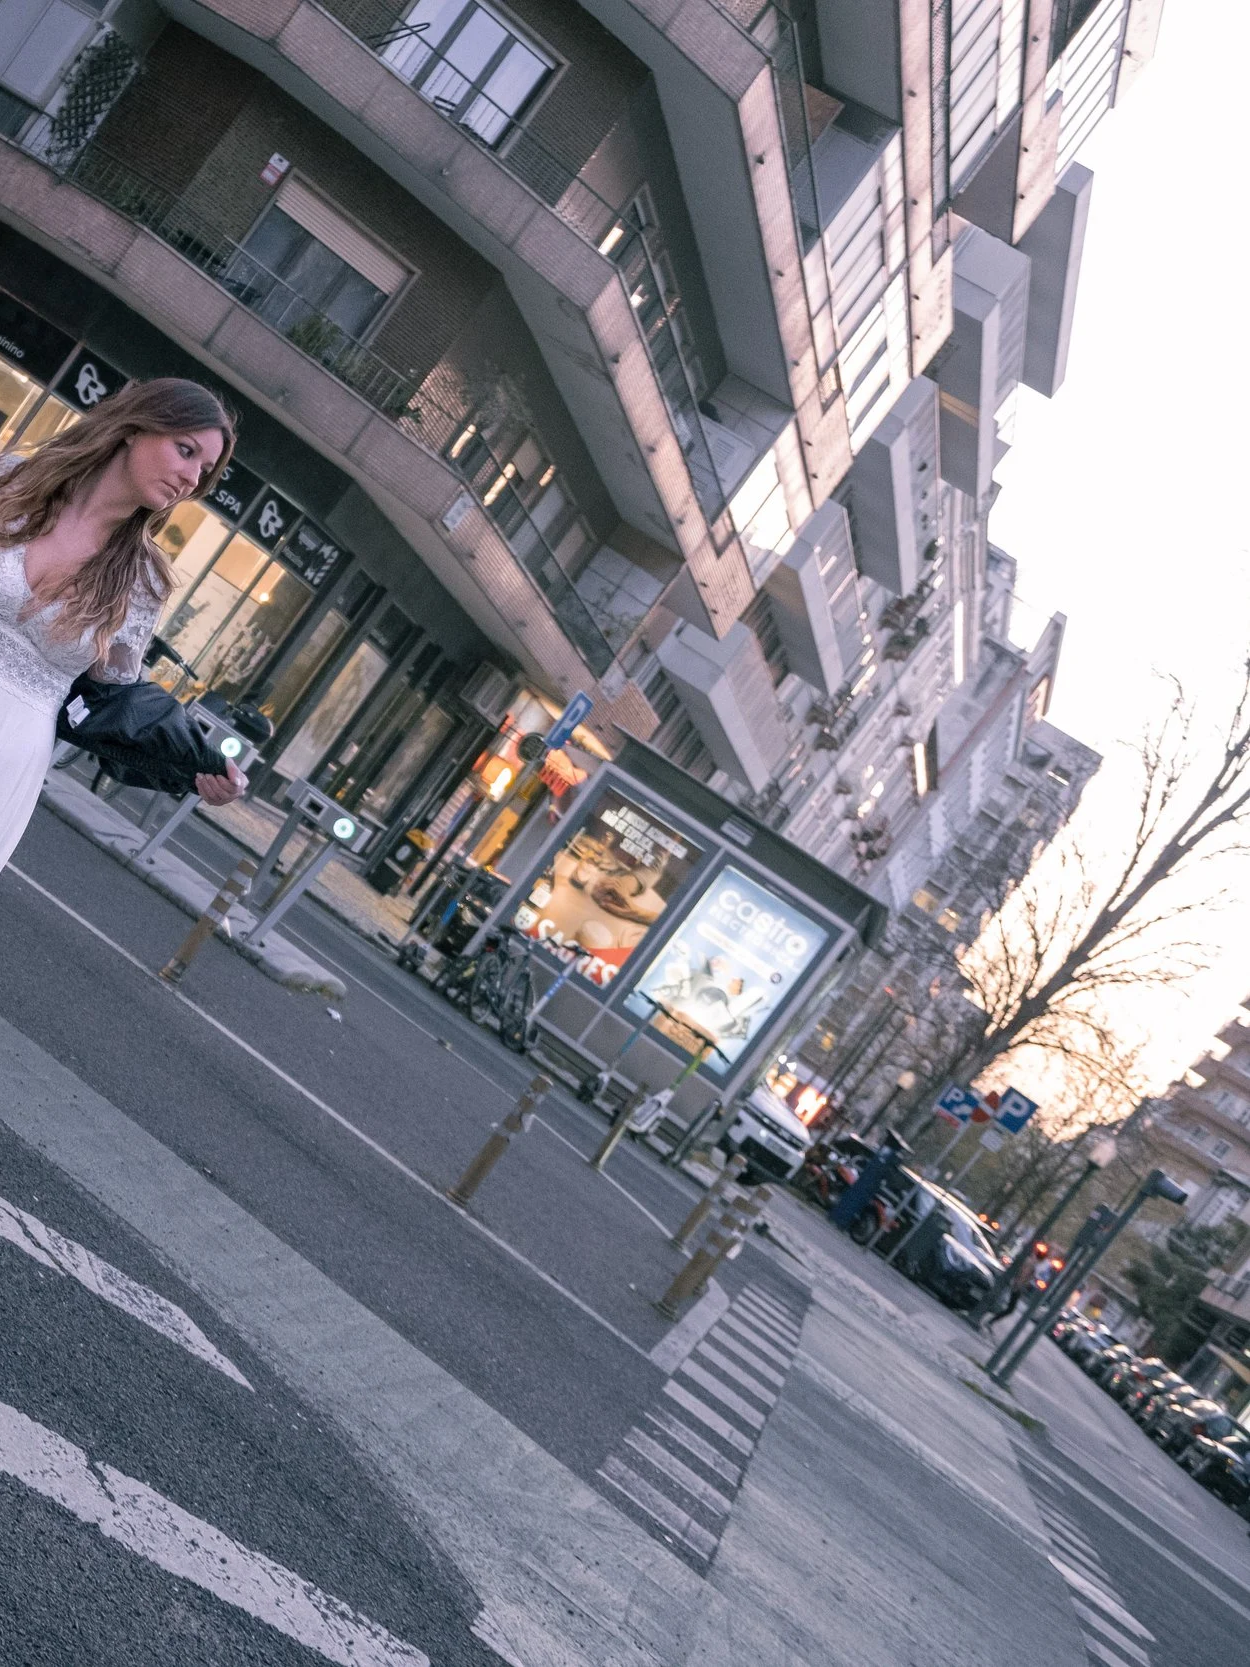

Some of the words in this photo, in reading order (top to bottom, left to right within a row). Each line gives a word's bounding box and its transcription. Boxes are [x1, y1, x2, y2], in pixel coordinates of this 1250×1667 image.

[215, 490, 242, 514] SPA
[718, 888, 808, 956] castro
[945, 1088, 965, 1103] P
[996, 1092, 1030, 1120] P
